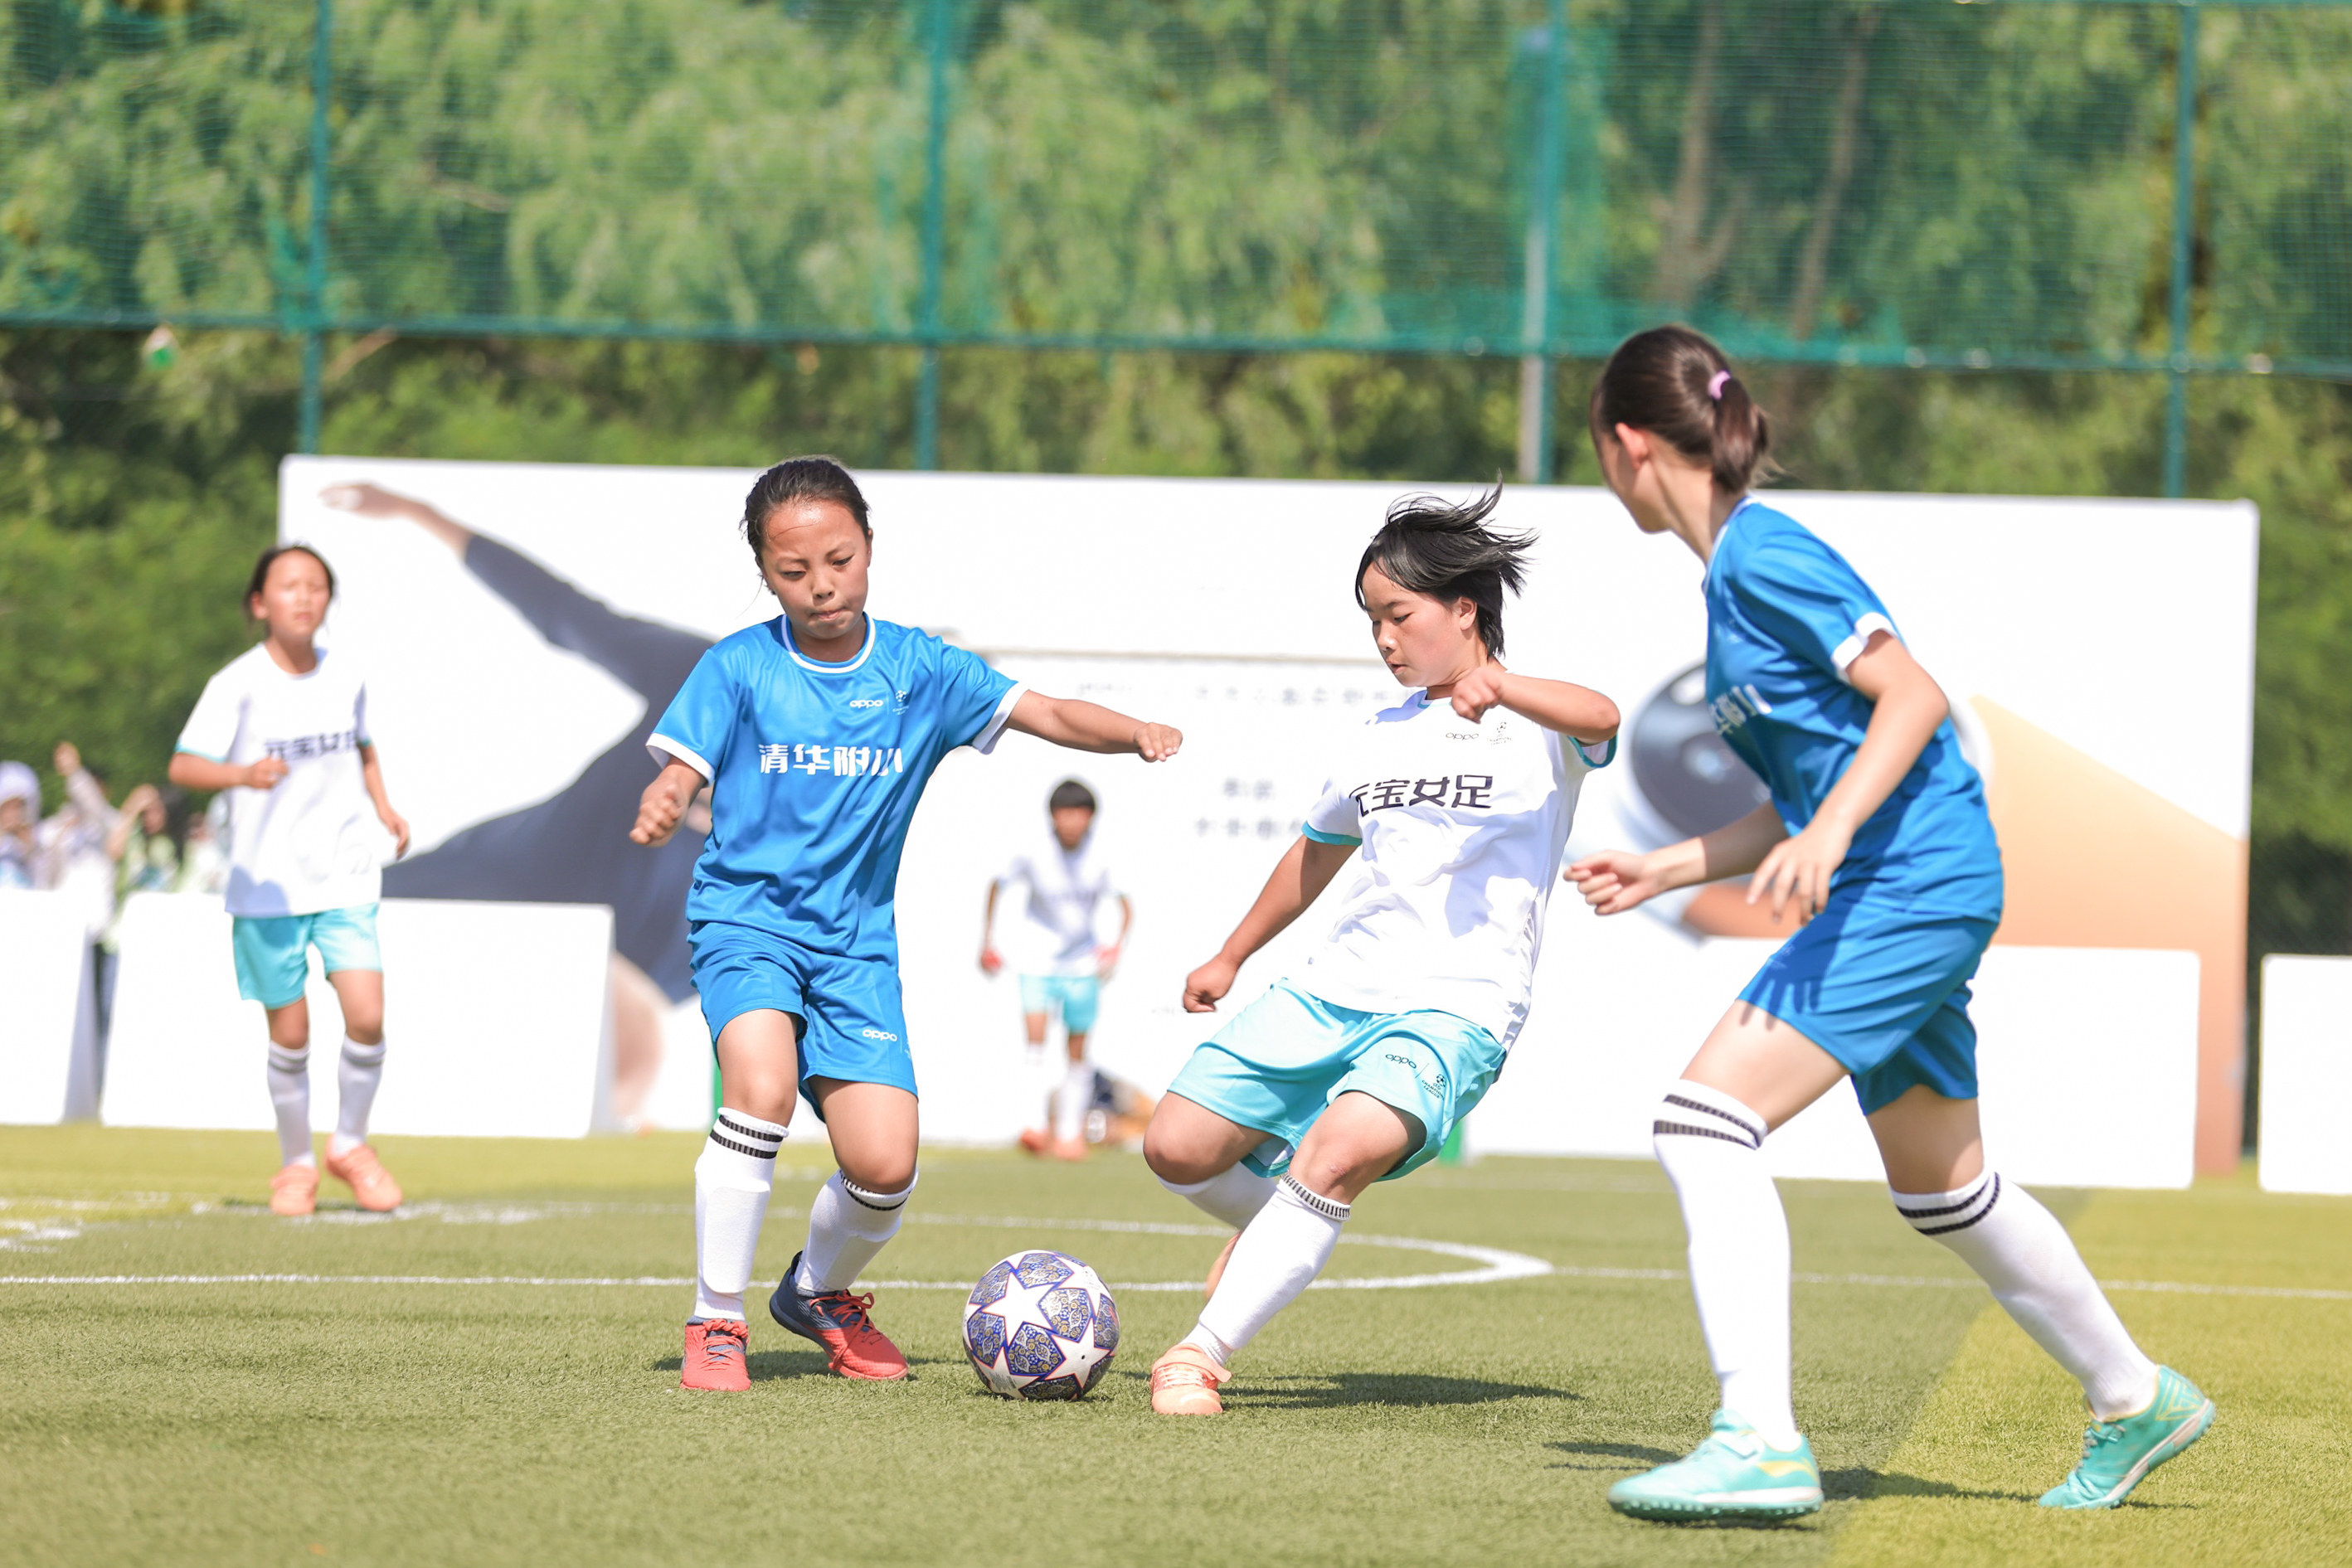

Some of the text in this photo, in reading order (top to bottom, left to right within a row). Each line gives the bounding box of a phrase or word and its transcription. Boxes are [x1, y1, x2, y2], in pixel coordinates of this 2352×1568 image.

[849, 699, 883, 708] oppo
[1445, 732, 1480, 741] oppo
[758, 743, 904, 777] 清华附小
[862, 1028, 898, 1042] oppo
[1385, 1054, 1417, 1069] oppo
